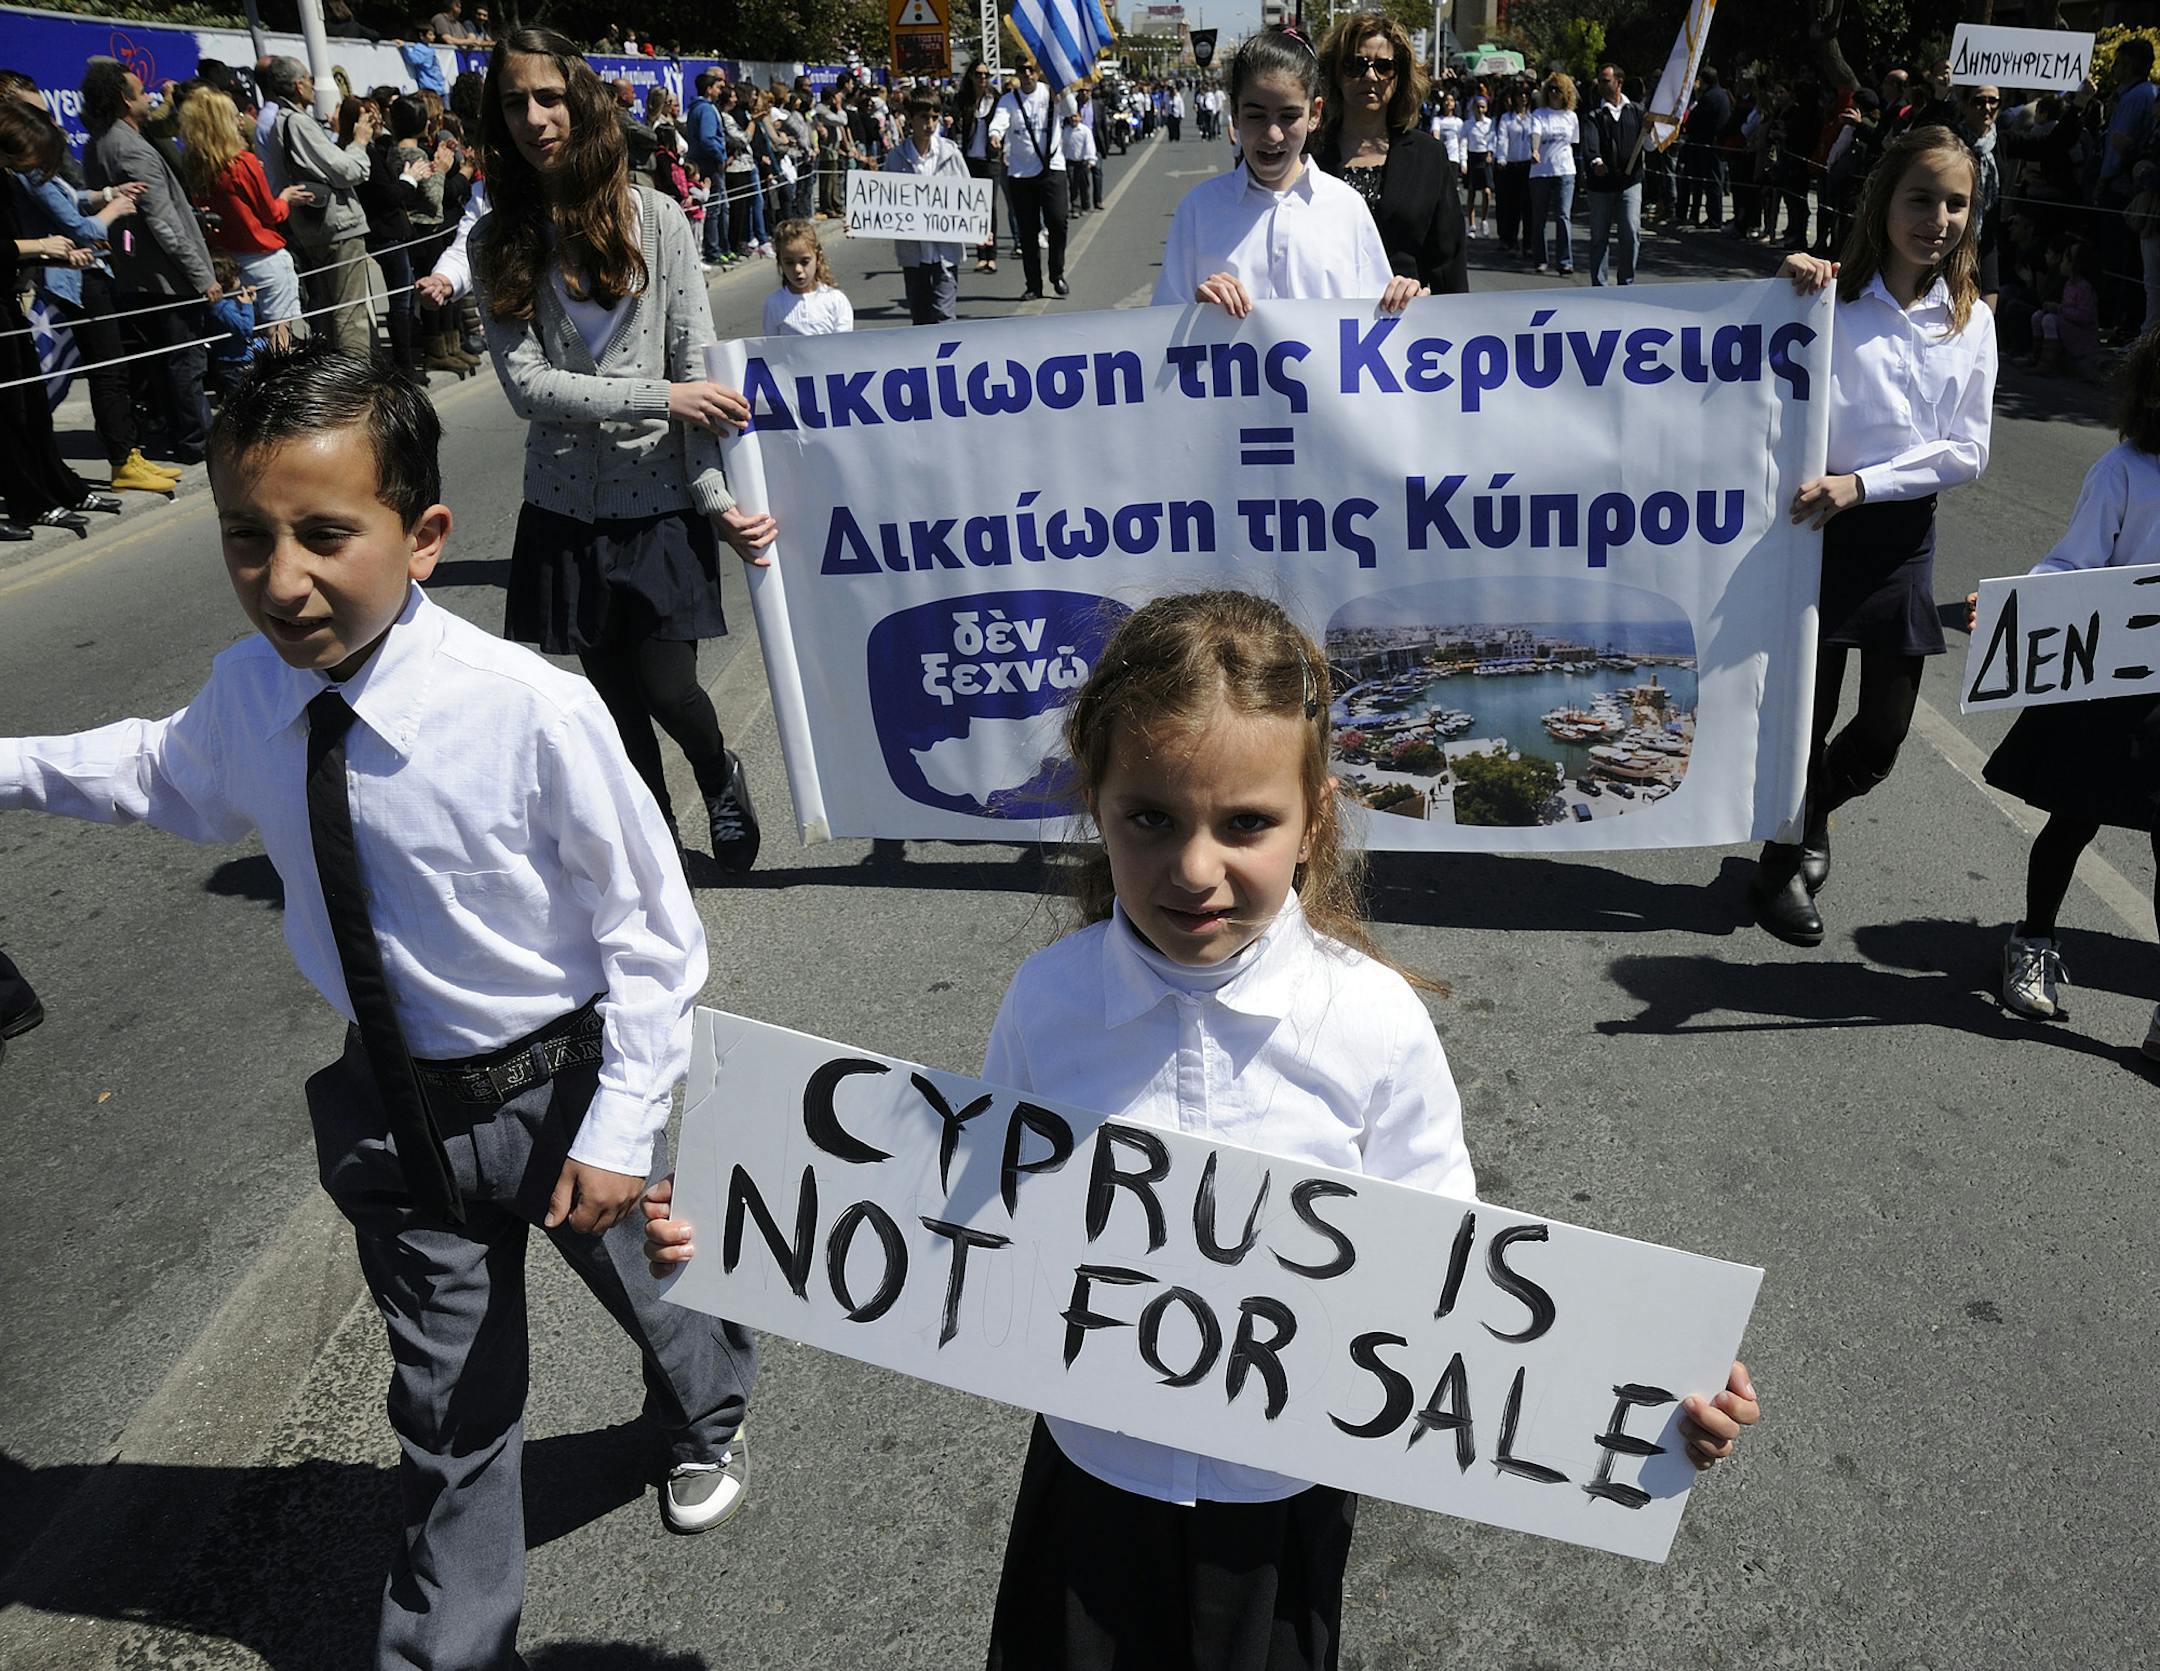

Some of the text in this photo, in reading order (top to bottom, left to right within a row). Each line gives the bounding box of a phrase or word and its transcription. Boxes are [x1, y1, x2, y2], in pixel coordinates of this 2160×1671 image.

[1952, 36, 2082, 82] ΔΗΜΟΨΗΦΙΣΜΑ
[851, 177, 989, 212] ΑΡΝΙΕΜΑΙ ΝΑ
[851, 210, 988, 235] ΔΗΛΩΣΩ ΥΠΟΤΑΓΗ
[738, 309, 1818, 436] Δικαίωση της Κερύνειας
[820, 473, 1746, 575] Δικαίωση της Κύπρου
[803, 1058, 1556, 1344] CYPRUS IS
[723, 1163, 1679, 1510] NOT FOR SALE
